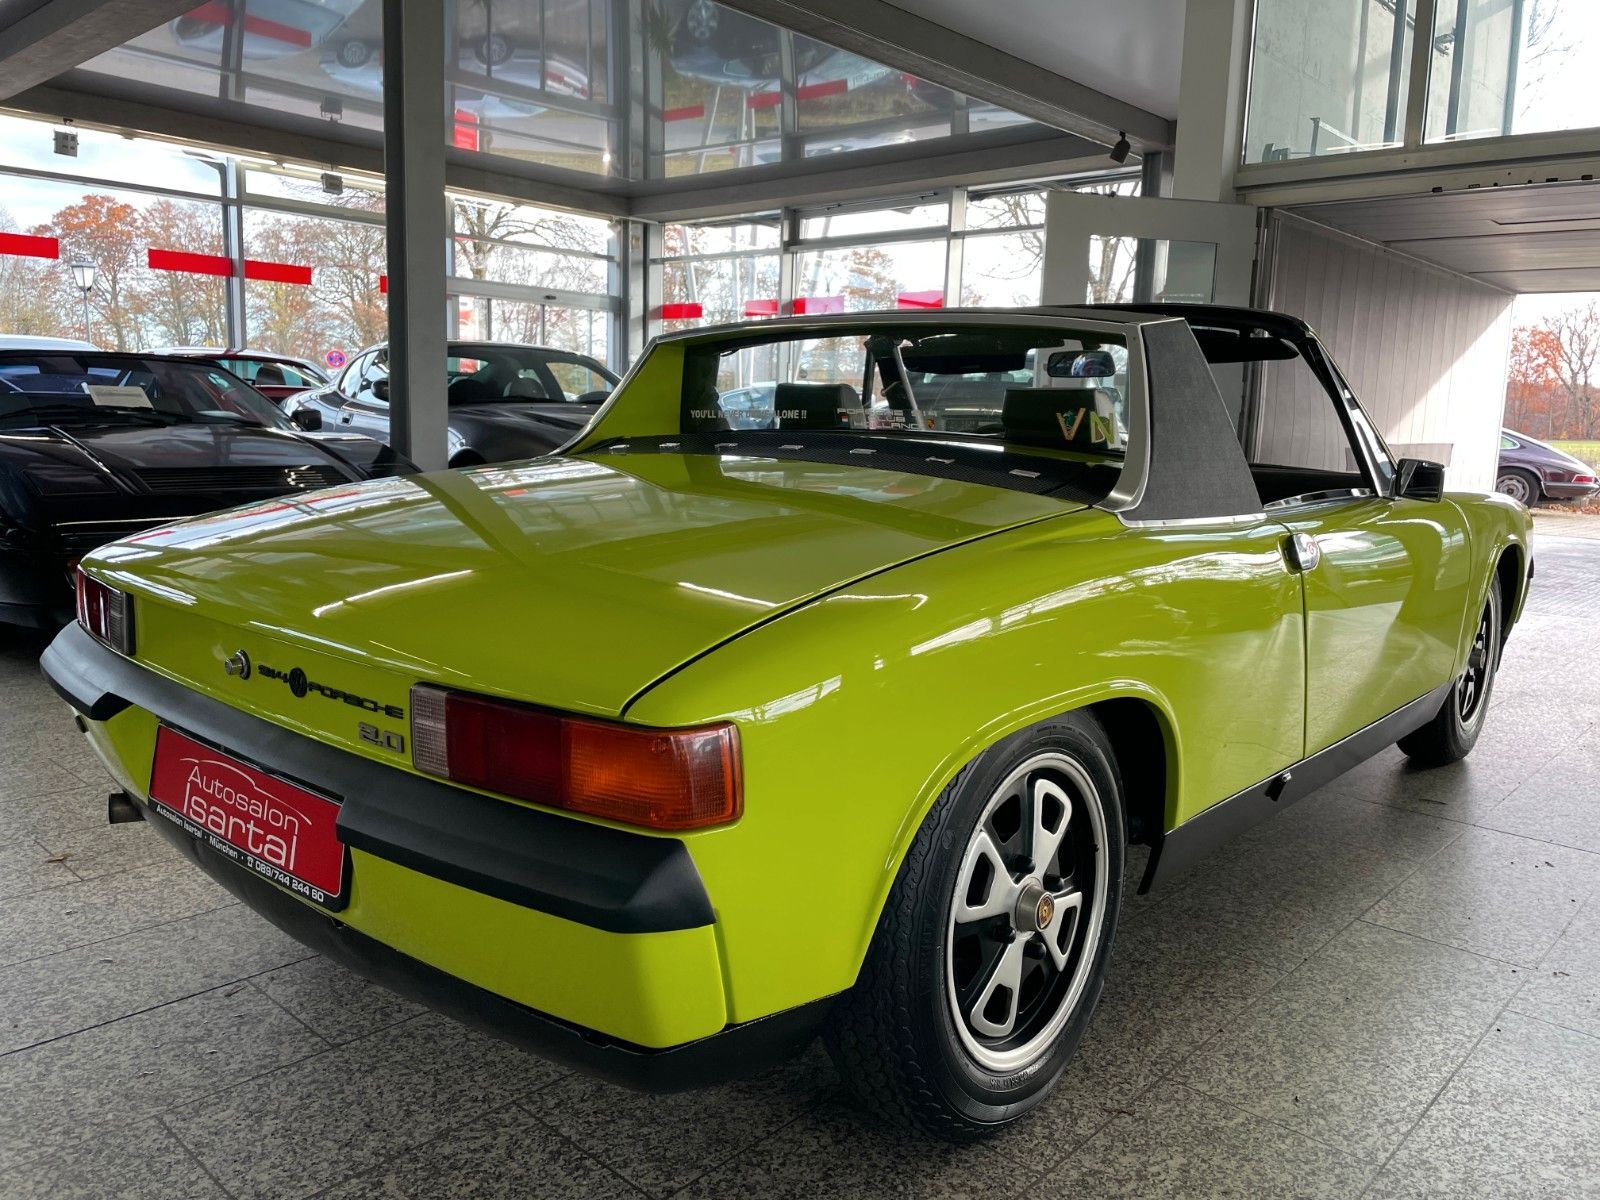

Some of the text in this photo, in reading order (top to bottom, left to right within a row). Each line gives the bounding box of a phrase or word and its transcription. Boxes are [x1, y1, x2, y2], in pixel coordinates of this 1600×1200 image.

[690, 409, 717, 419] YOU'LL
[745, 409, 770, 419] DVE
[307, 681, 404, 720] PORSCHE
[358, 721, 405, 753] 2.0
[183, 782, 298, 871] Isartal
[188, 765, 299, 835] Autosalon
[156, 804, 325, 903] Autosalon Isartal München 089/744 244 60
